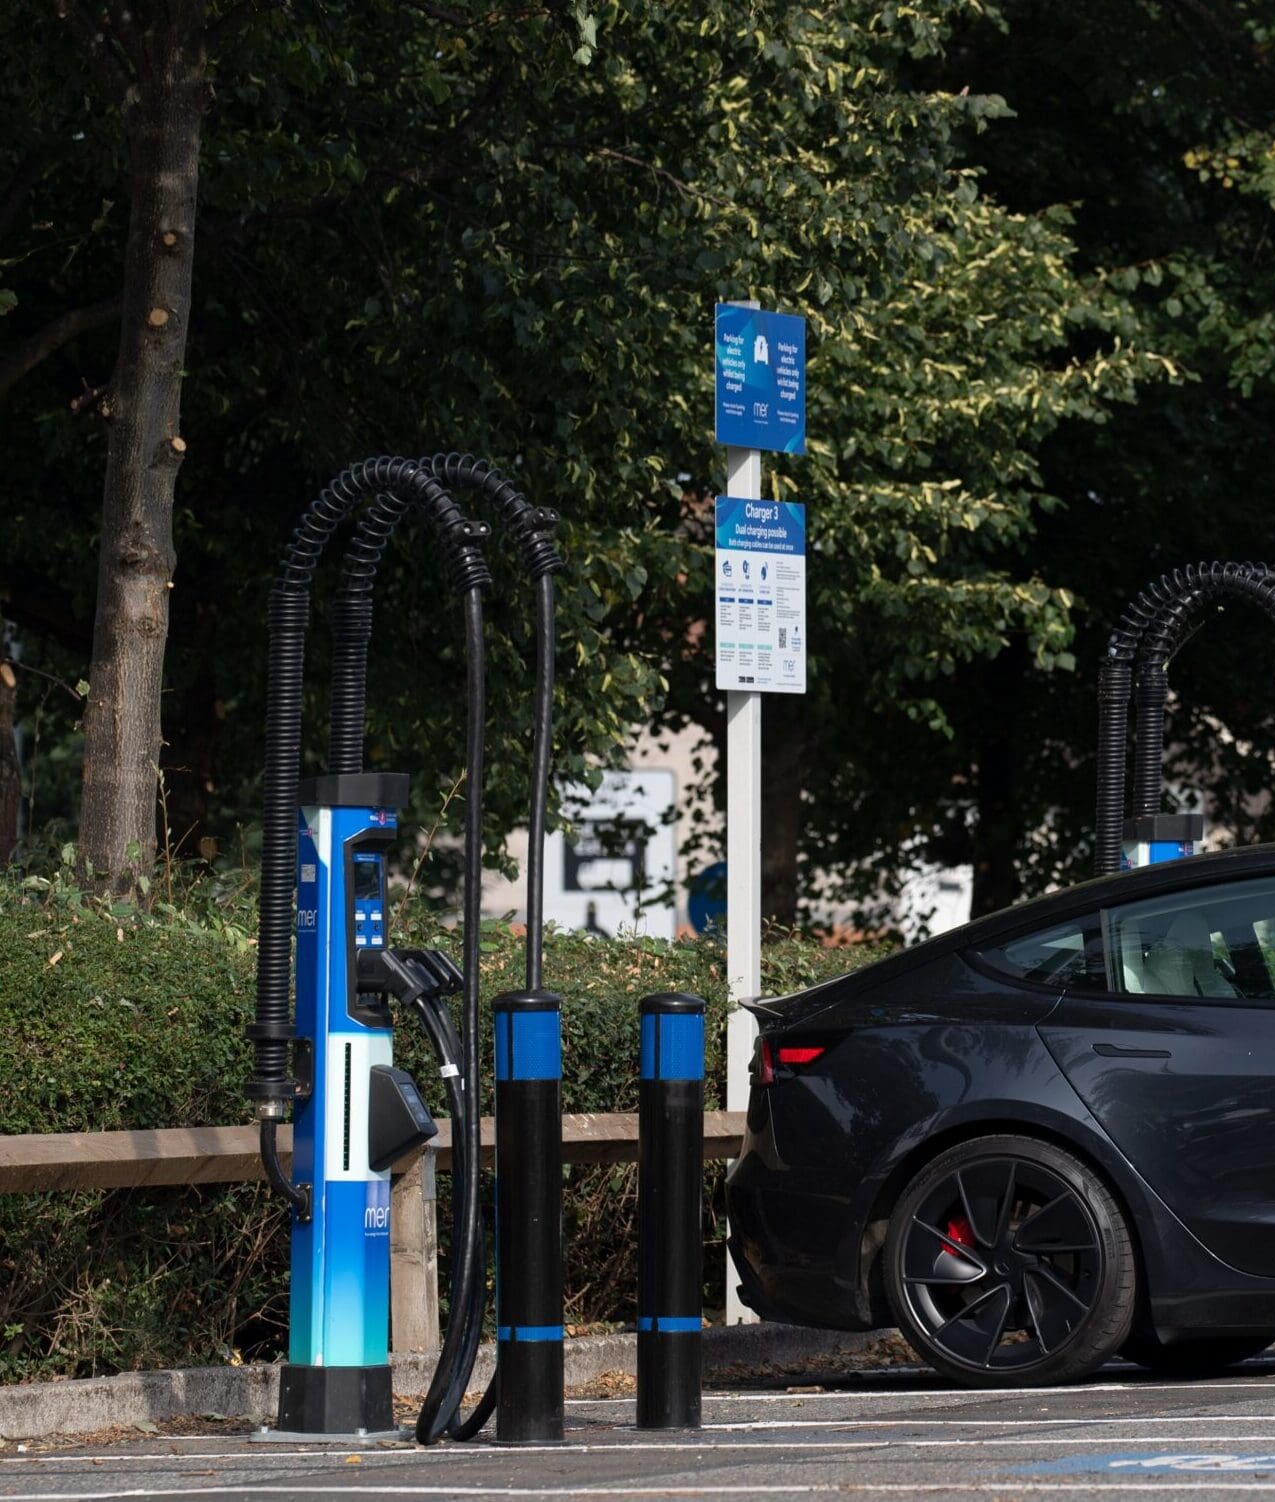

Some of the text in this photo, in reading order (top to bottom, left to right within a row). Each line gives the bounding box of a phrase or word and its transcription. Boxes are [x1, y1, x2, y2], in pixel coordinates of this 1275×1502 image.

[745, 503, 779, 523] Charger 3
[735, 524, 787, 540] Dual charging possible
[298, 909, 317, 927] mer
[364, 1206, 390, 1229] mer
